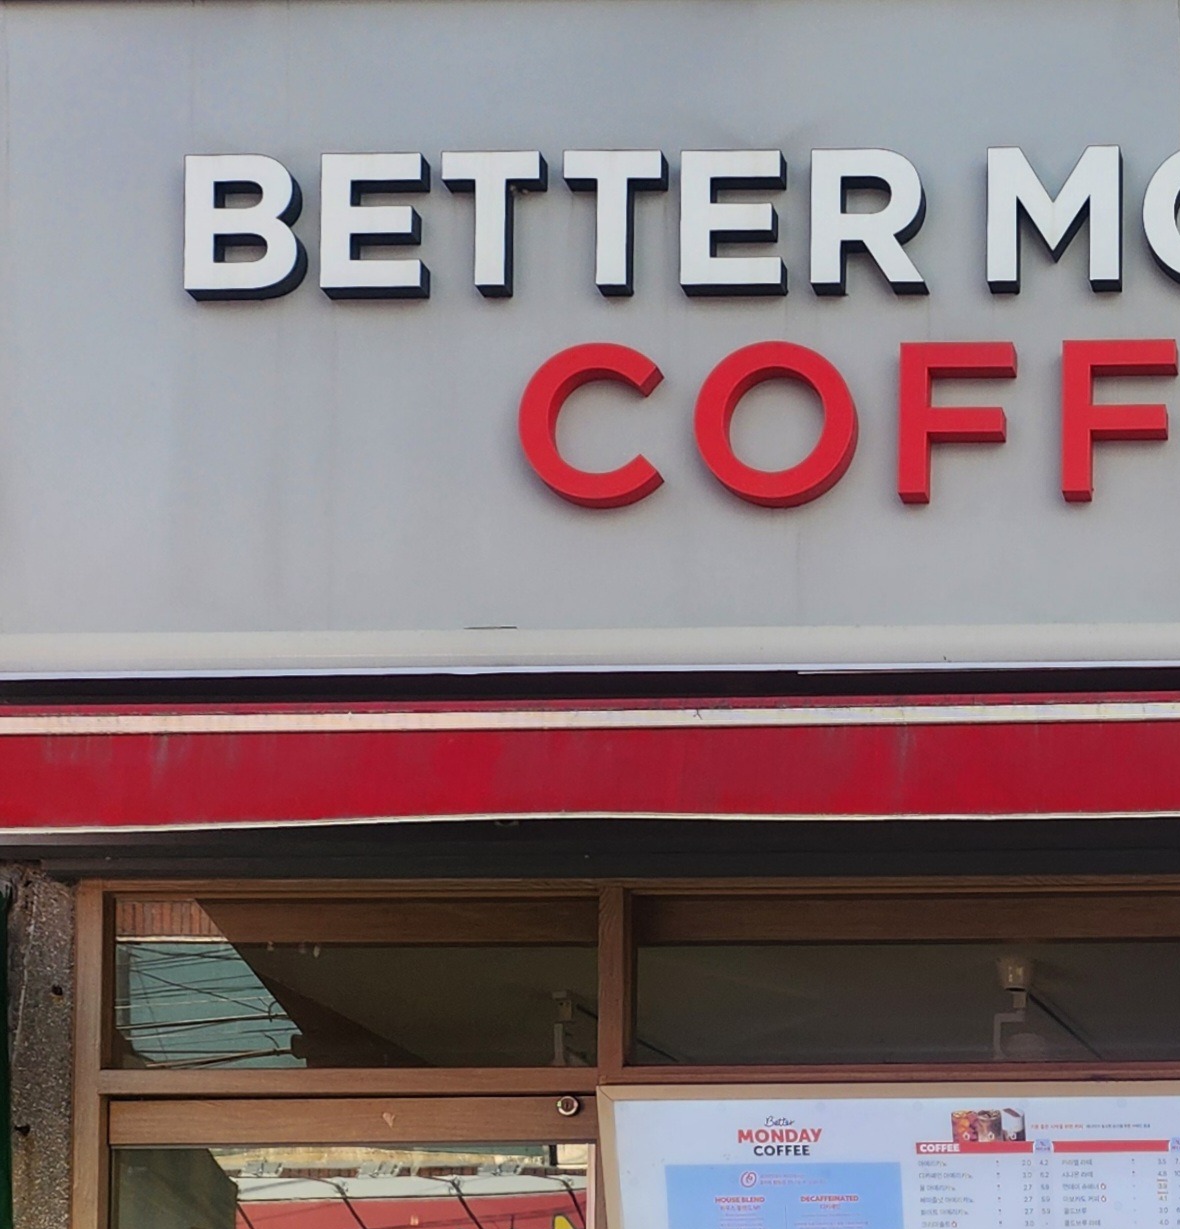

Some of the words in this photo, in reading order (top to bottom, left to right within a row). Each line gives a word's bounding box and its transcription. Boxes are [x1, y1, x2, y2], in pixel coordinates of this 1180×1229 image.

[183, 147, 929, 302] BETTER
[764, 1116, 795, 1127] Better
[738, 1128, 822, 1143] MONDAY
[754, 1145, 810, 1156] COFFEE
[920, 1144, 960, 1152] COFFEE
[715, 1196, 739, 1204] HOUSE
